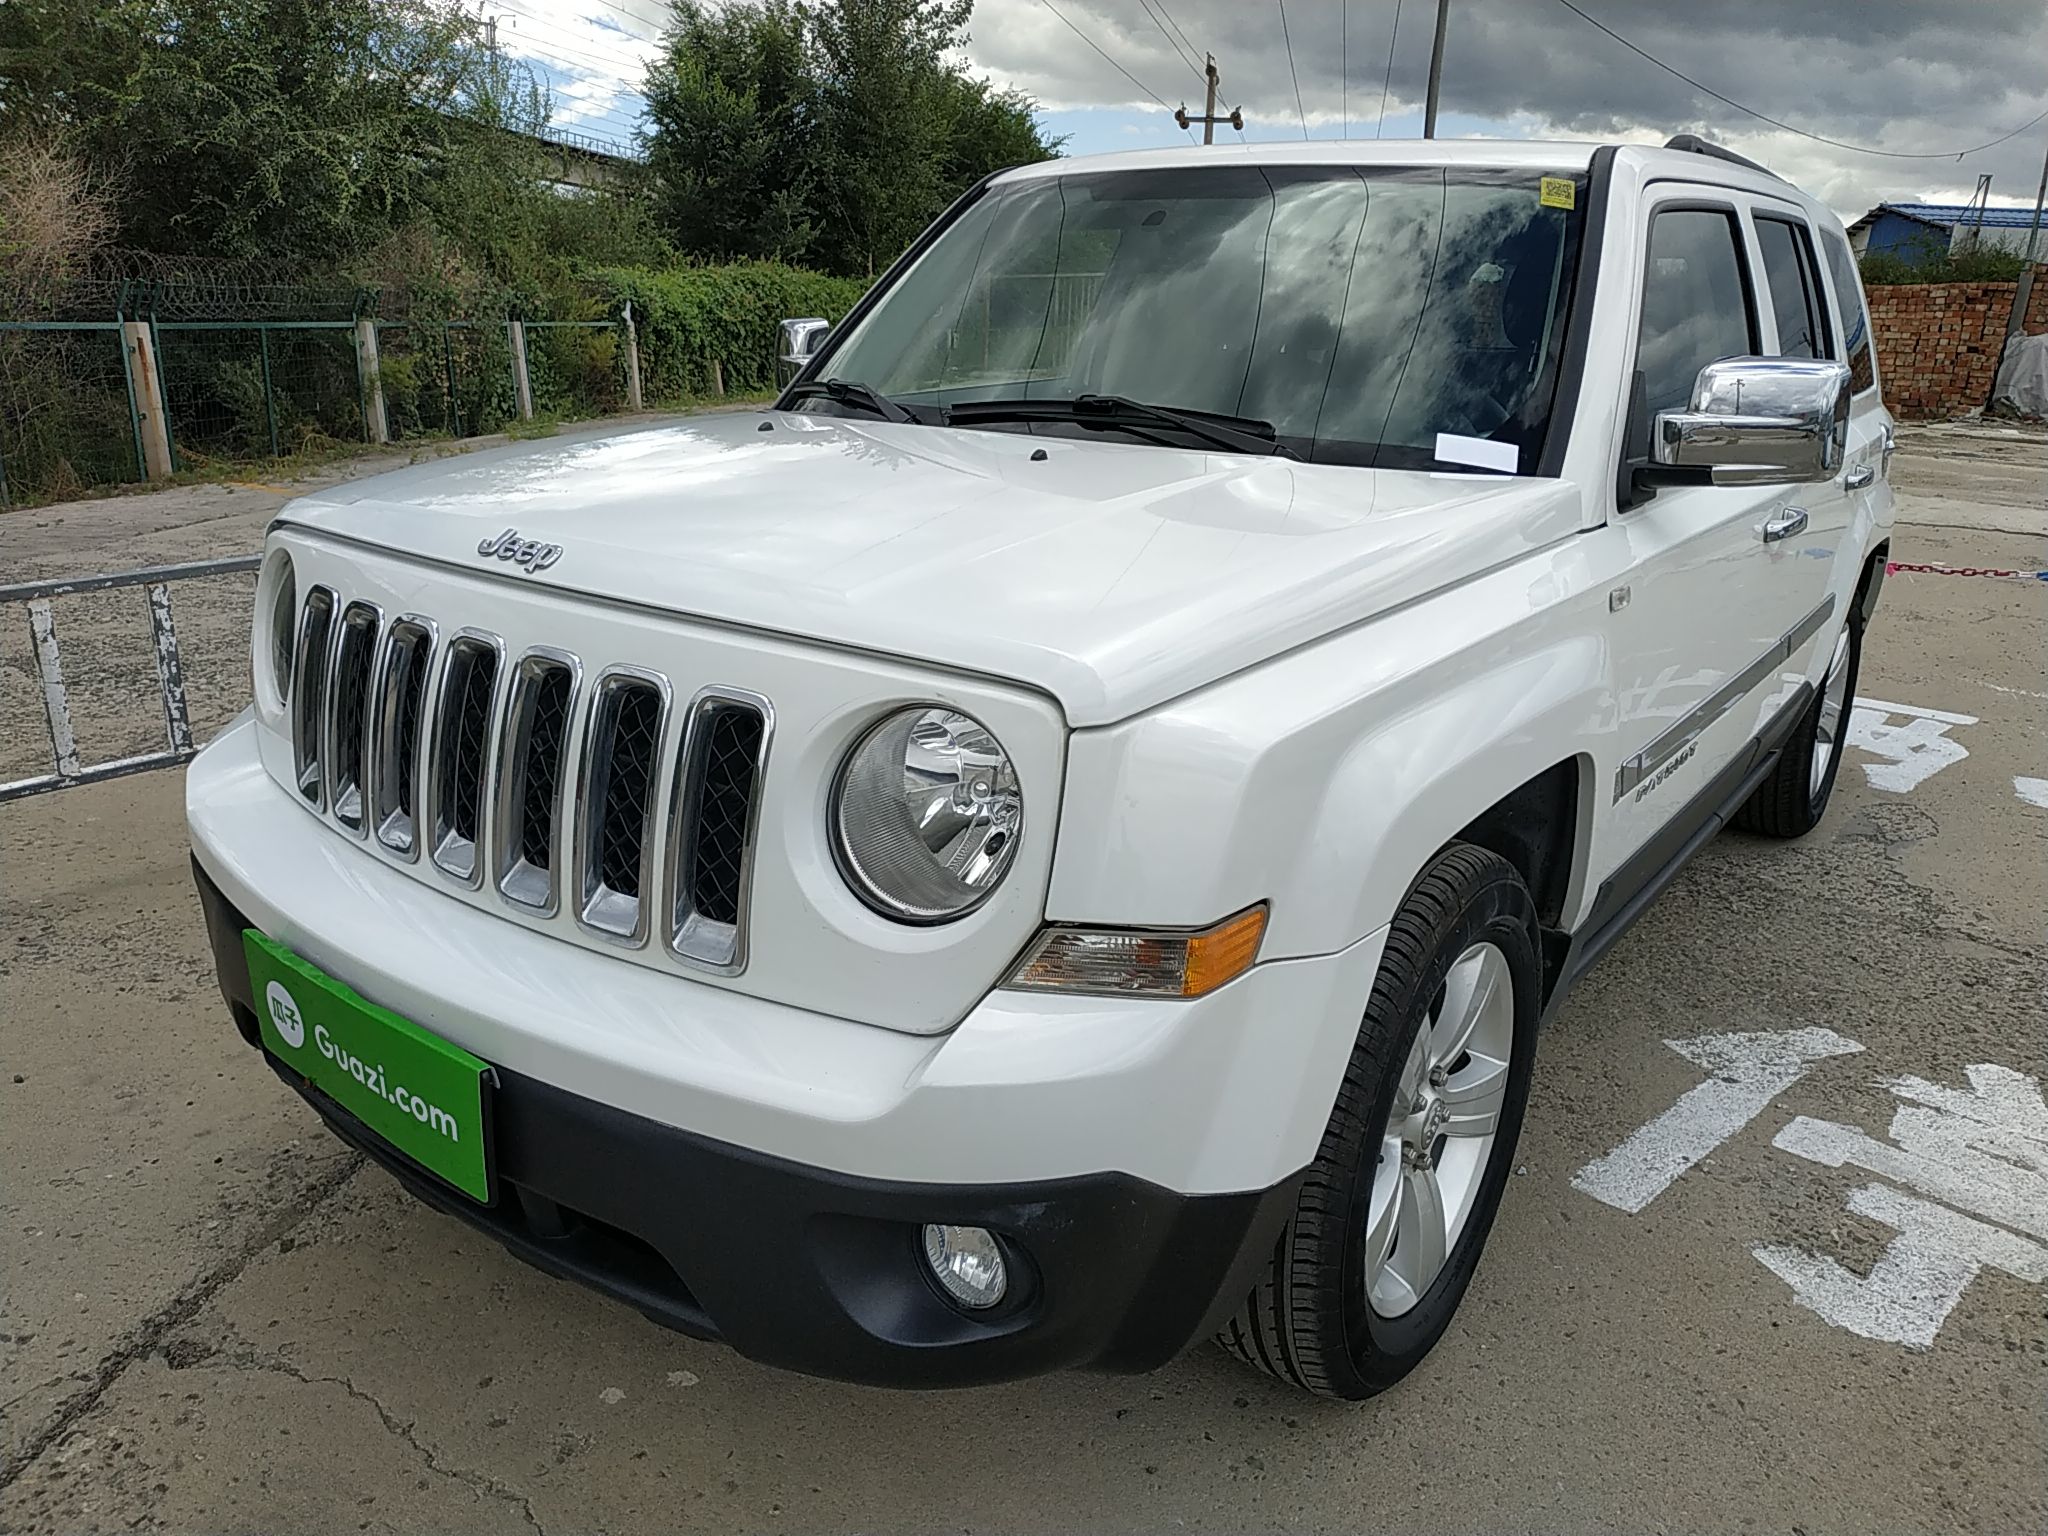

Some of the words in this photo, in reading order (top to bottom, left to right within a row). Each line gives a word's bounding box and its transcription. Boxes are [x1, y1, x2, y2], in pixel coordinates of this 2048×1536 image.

[477, 527, 564, 574] Jeep
[270, 995, 300, 1031] 瓜子
[314, 1023, 459, 1143] Guazi.com
